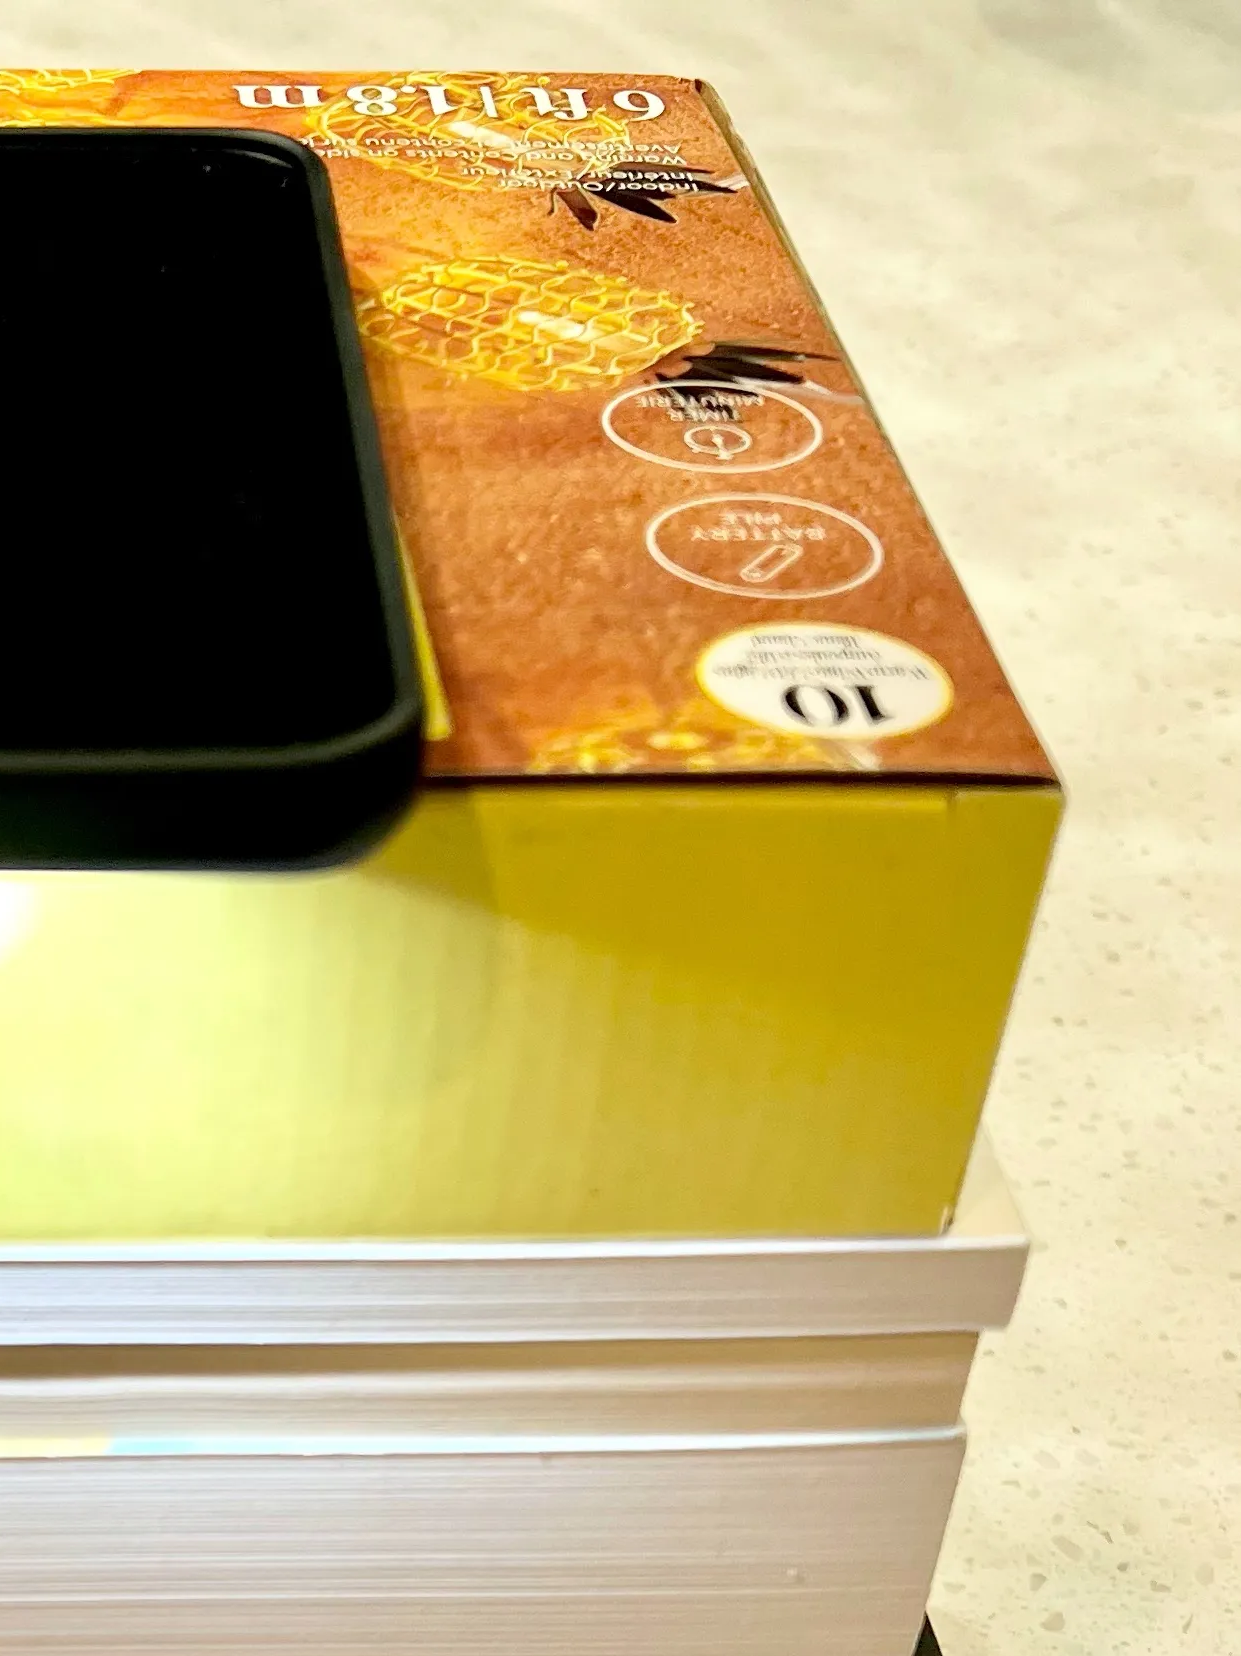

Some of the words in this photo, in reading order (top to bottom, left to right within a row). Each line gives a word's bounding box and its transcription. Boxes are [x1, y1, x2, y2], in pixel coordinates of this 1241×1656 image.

[233, 84, 323, 109] m
[346, 84, 458, 117] 1.8
[522, 86, 593, 121] ft
[612, 89, 666, 122] 6
[365, 137, 465, 147] contenu
[368, 148, 399, 157] on
[405, 149, 519, 162] Contents
[525, 151, 574, 162] and
[580, 150, 687, 166] Warning
[498, 177, 699, 192] Indoor/Outdoor
[636, 394, 765, 409] MINUTERIE
[667, 408, 742, 422] TIMER
[719, 511, 782, 525] PILE
[690, 525, 827, 542] BATTERY
[780, 684, 893, 727] 10
